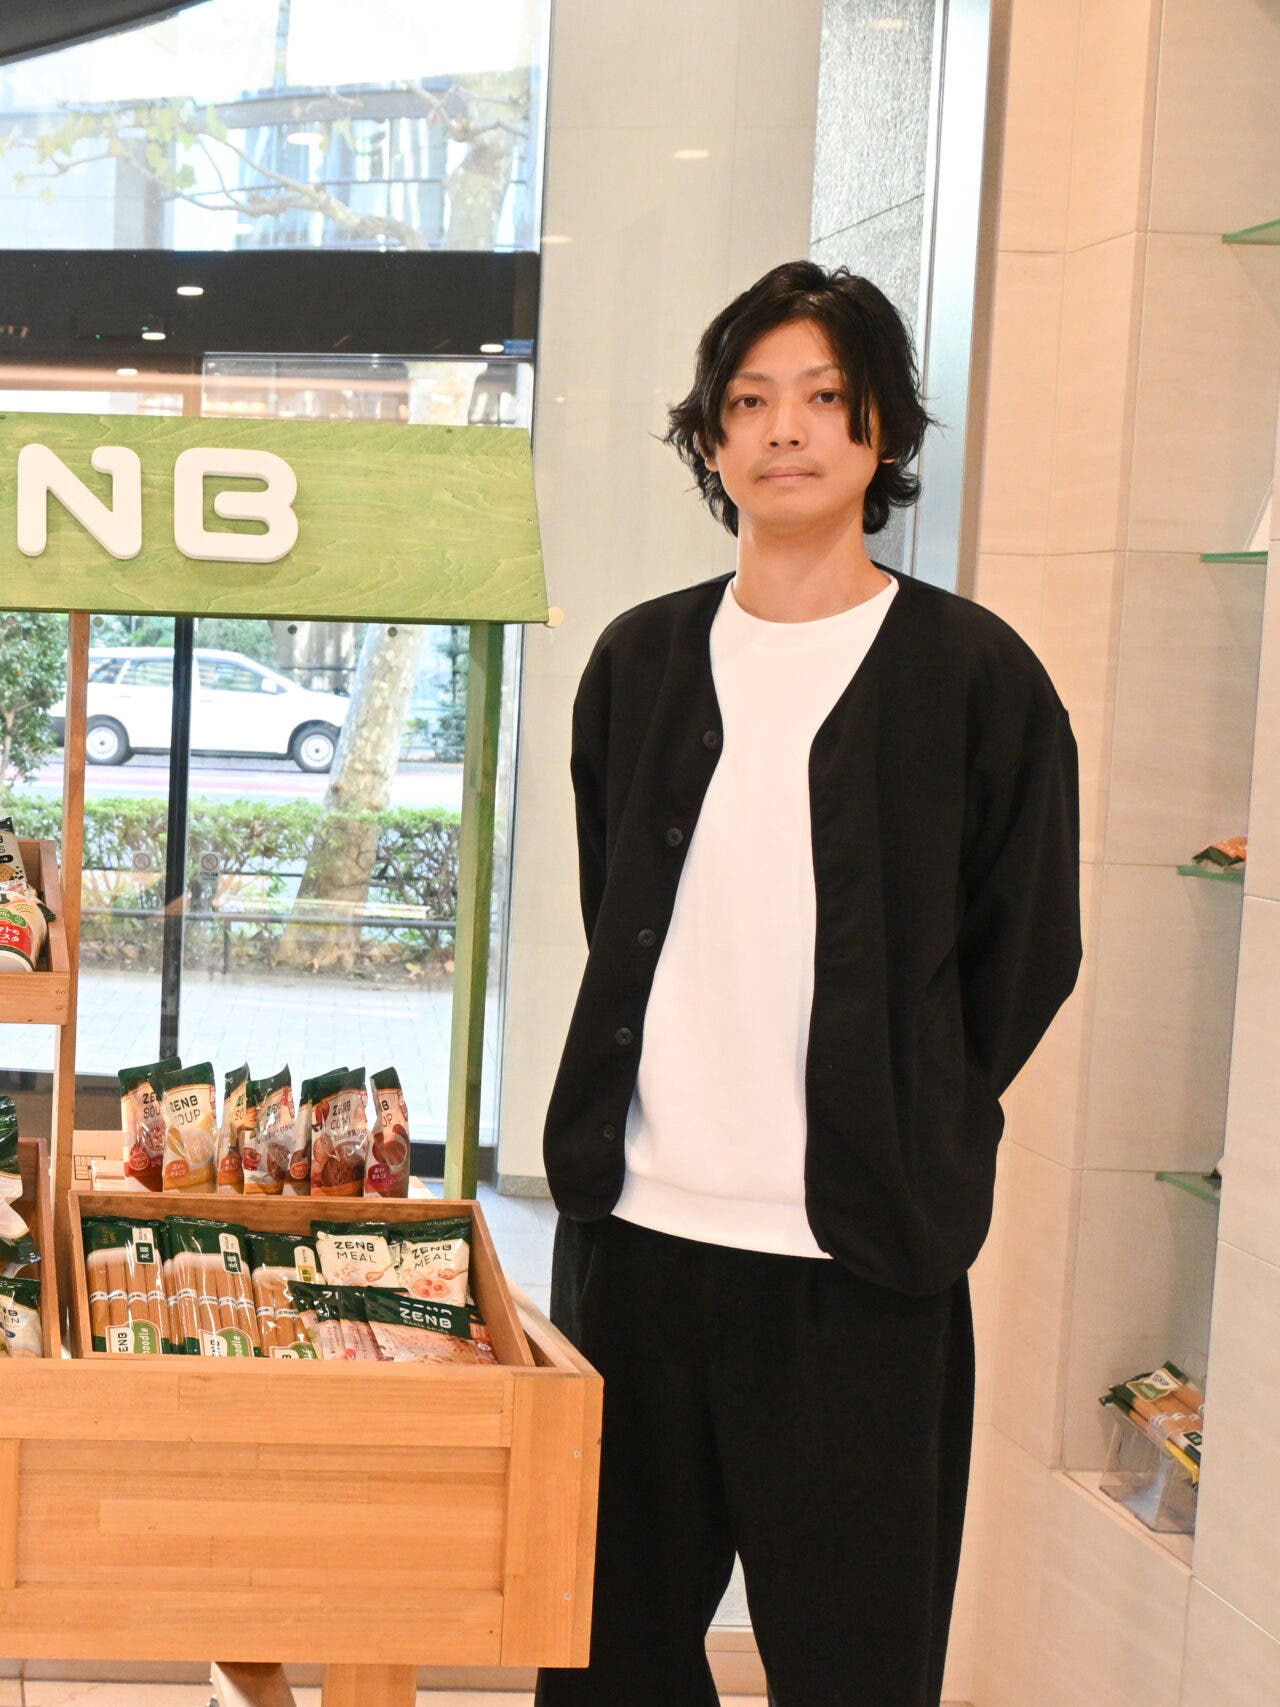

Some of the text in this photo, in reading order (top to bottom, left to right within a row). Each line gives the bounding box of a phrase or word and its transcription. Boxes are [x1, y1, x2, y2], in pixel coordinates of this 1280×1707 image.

[143, 1105, 161, 1119] SOU
[334, 1241, 375, 1252] ZENB
[412, 1243, 452, 1259] ZENB
[337, 1251, 377, 1264] MEAL
[414, 1253, 453, 1270] MEAL
[399, 1307, 452, 1329] ZENB
[118, 1332, 128, 1353] ENB
